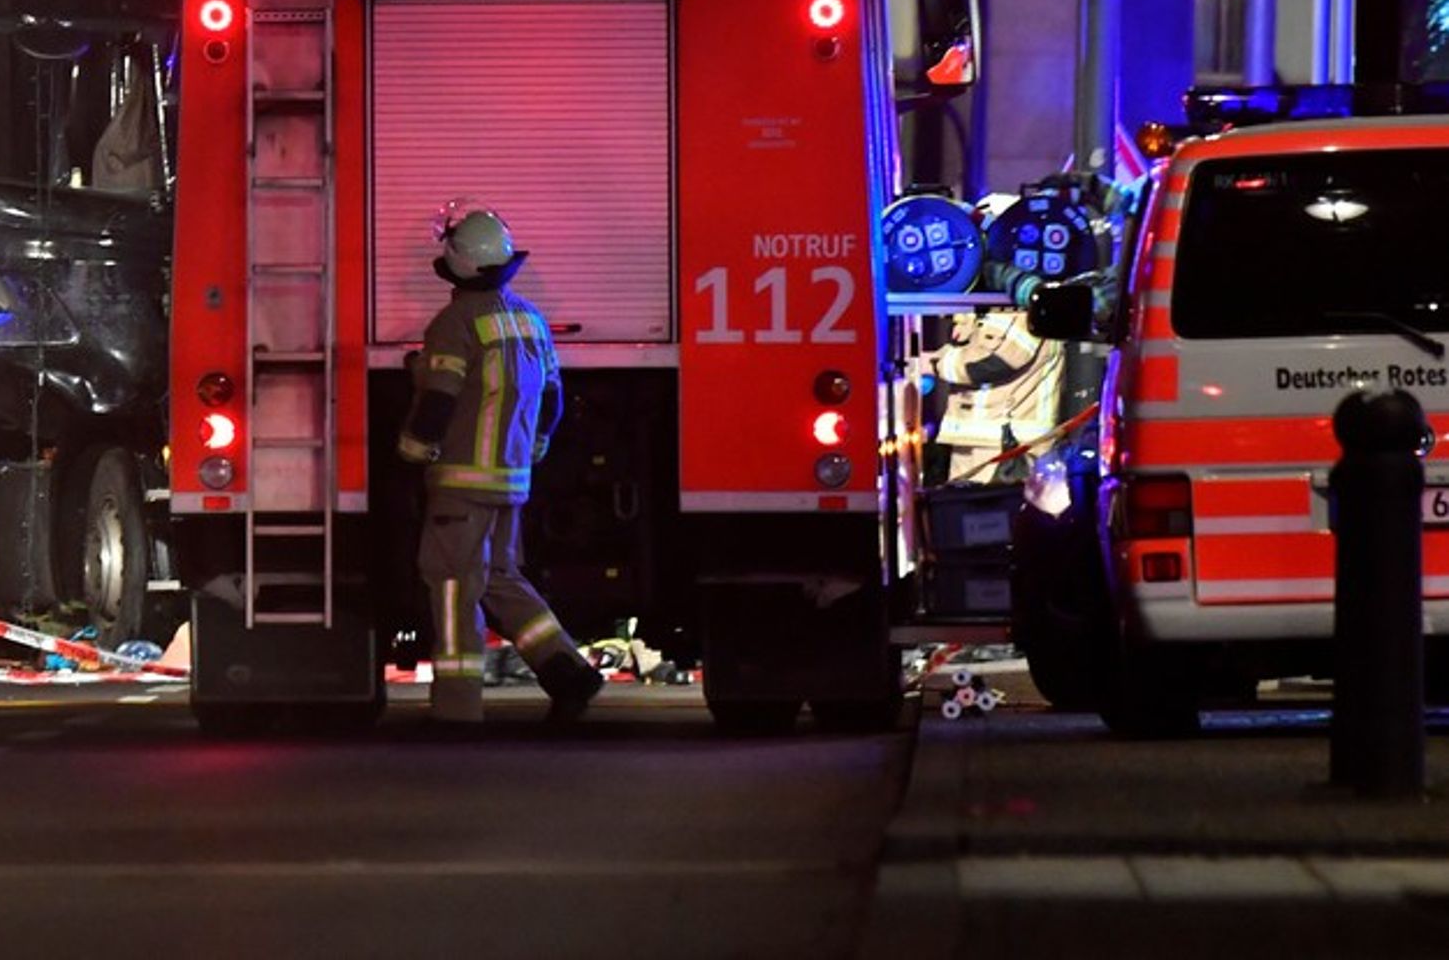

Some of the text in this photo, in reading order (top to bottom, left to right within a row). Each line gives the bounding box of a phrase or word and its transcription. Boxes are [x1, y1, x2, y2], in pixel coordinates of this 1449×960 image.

[753, 234, 857, 258] NOTRUF
[695, 266, 857, 344] 112
[1388, 365, 1447, 388] Rotes
